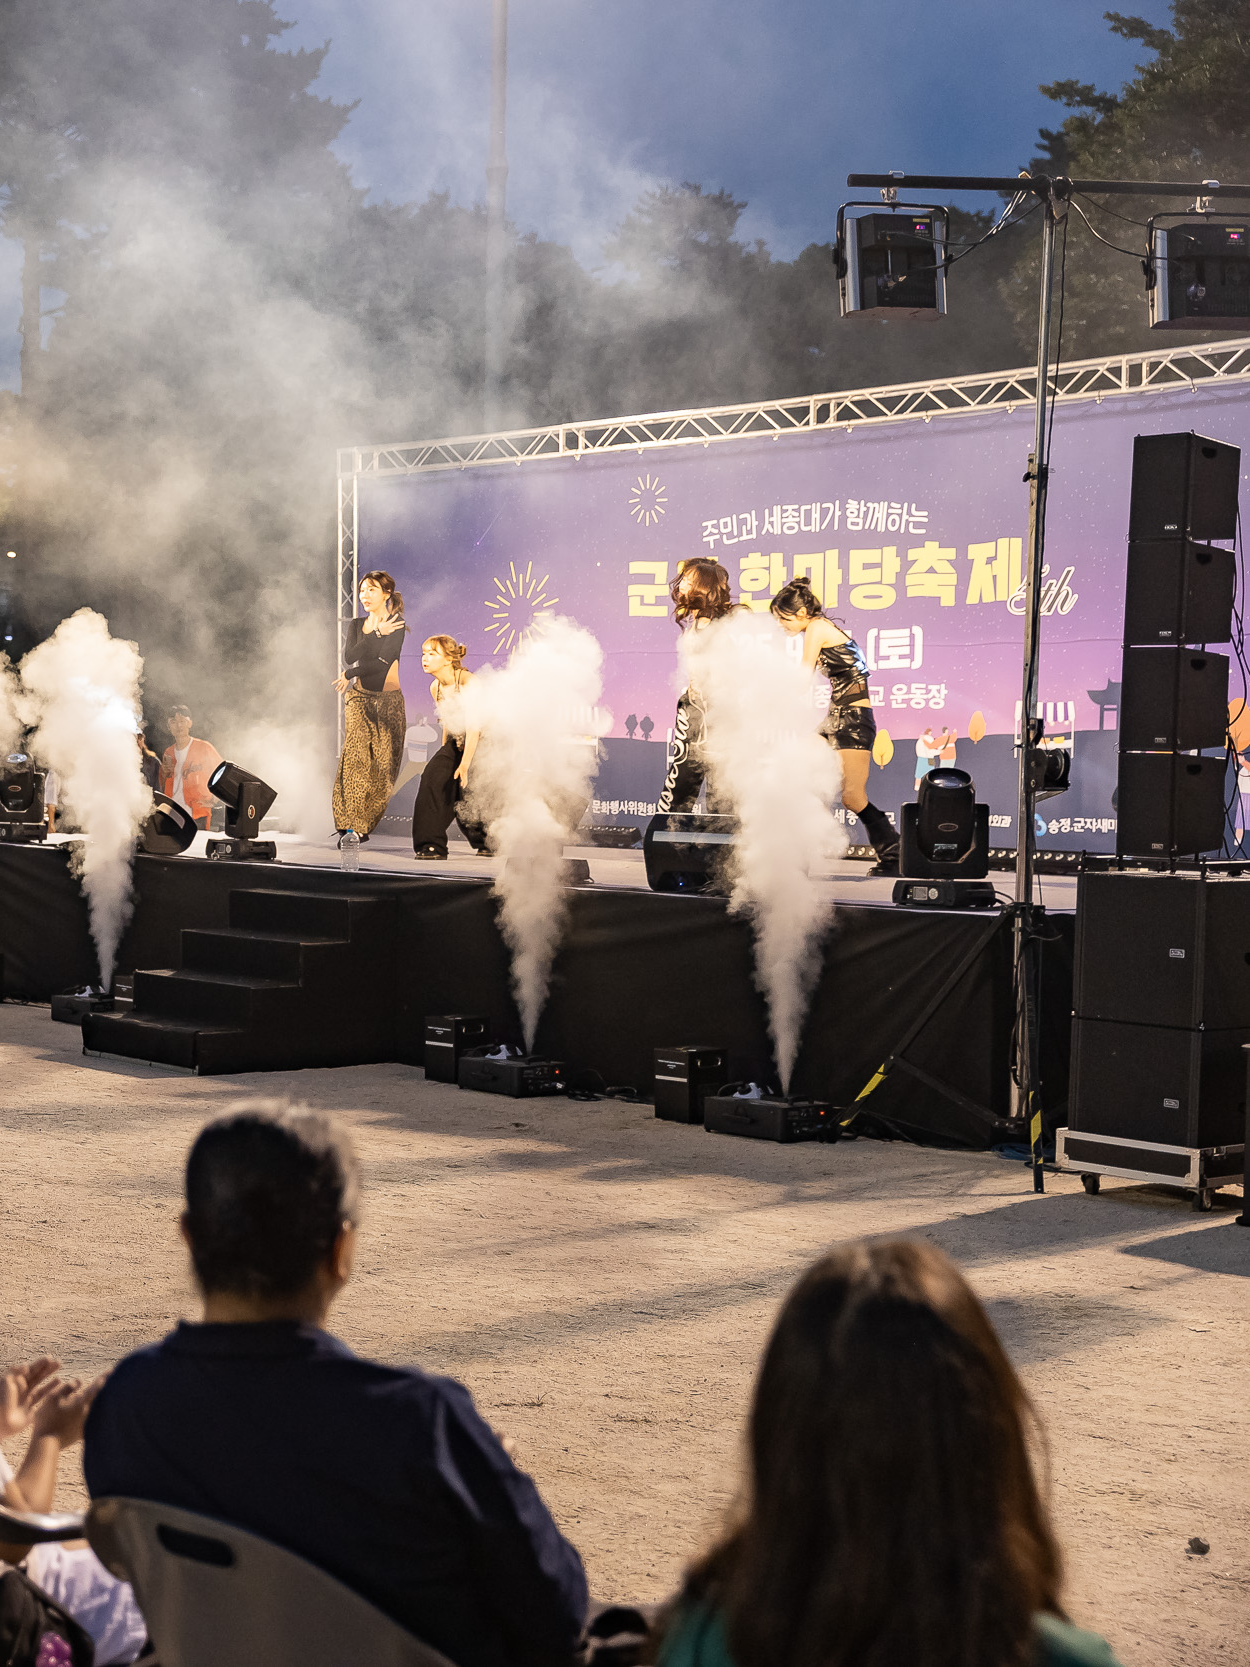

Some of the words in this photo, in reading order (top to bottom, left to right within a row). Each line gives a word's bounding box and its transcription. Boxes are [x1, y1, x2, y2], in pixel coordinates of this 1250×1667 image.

[701, 509, 759, 550] 주민과
[761, 499, 842, 536] 세종대가
[845, 498, 930, 535] 함께하는
[738, 537, 1023, 614] 한마당축제
[889, 682, 948, 710] 운동장
[592, 799, 657, 817] 문화행사위원회
